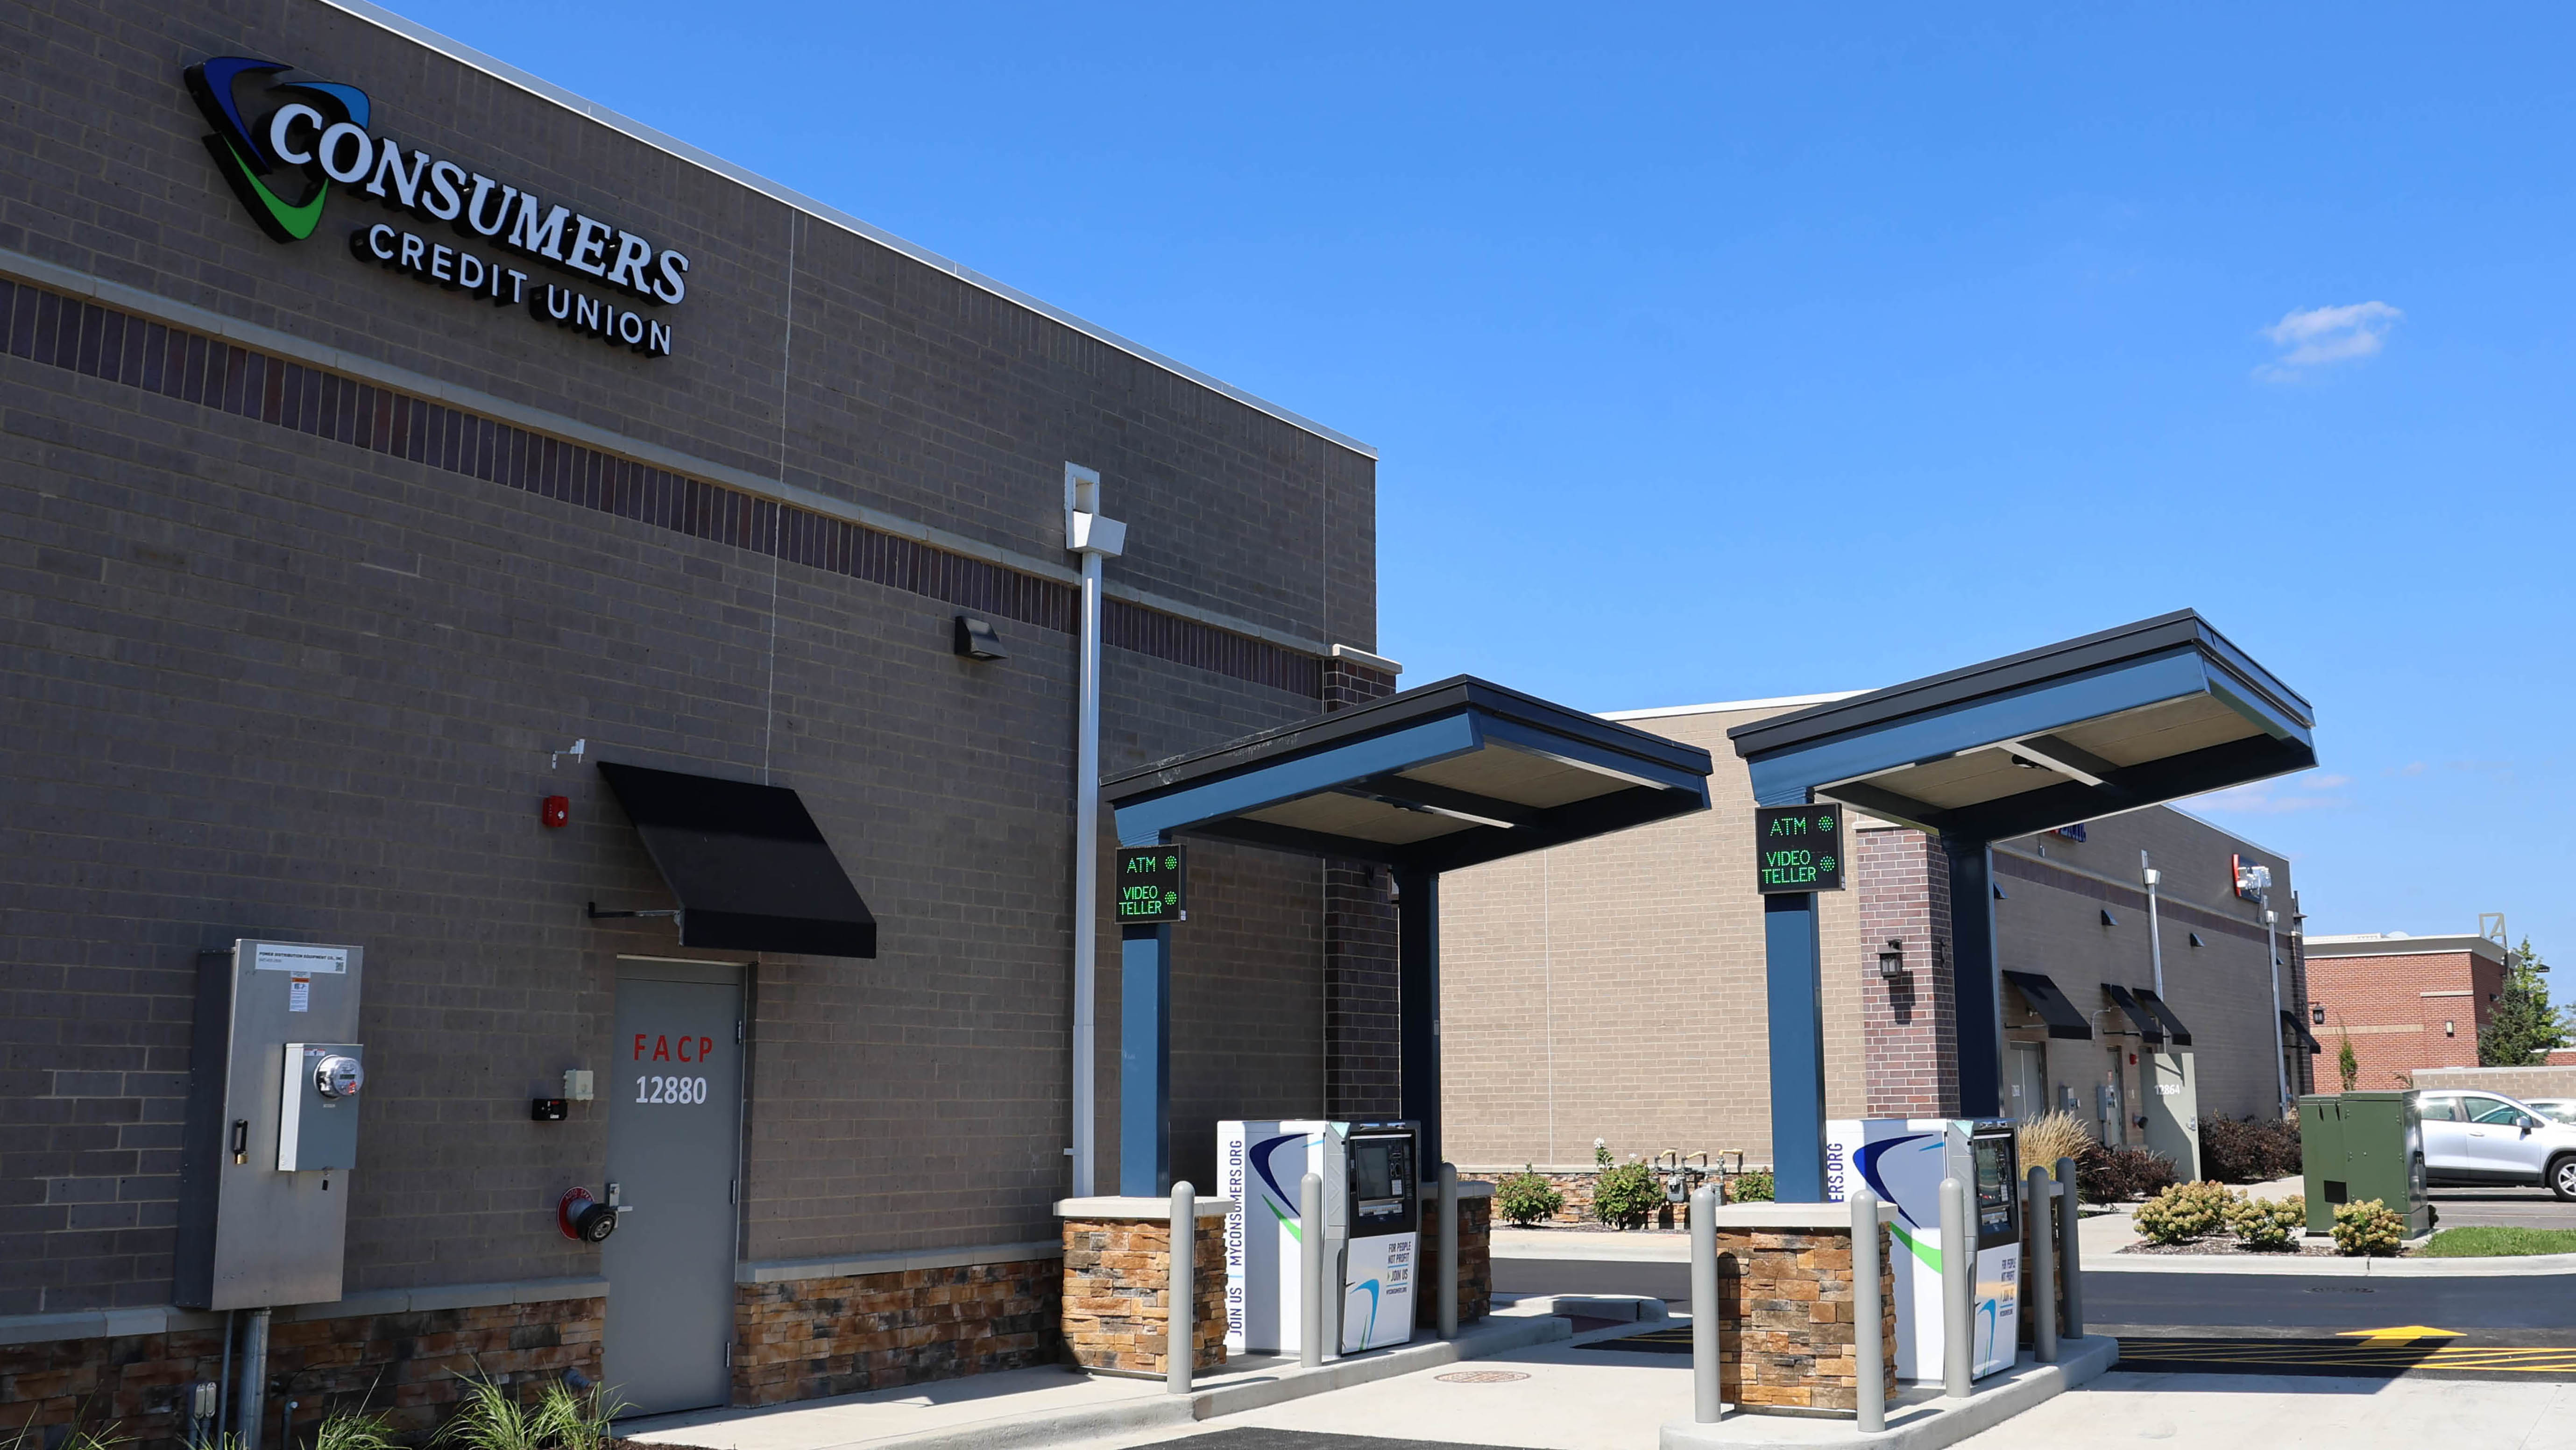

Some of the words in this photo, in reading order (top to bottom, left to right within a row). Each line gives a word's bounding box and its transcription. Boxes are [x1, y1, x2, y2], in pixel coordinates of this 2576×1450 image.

[270, 103, 690, 305] CONSUMERS
[369, 223, 529, 303] CREDIT
[547, 283, 672, 355] UNION
[1770, 817, 1806, 836] ATM
[1126, 857, 1156, 874] ATM
[1766, 849, 1811, 867] VIDEO
[1762, 867, 1817, 884] TELLER
[1123, 886, 1158, 900] VIDEO
[1119, 901, 1162, 915] TELLER
[633, 1034, 713, 1062] FACP
[636, 1076, 707, 1104] 12880
[2154, 1084, 2180, 1095] 12864
[1391, 1270, 1401, 1282] JOIN
[1401, 1269, 1408, 1280] US
[1230, 1287, 1242, 1303] US
[1230, 1308, 1242, 1336] JOIN
